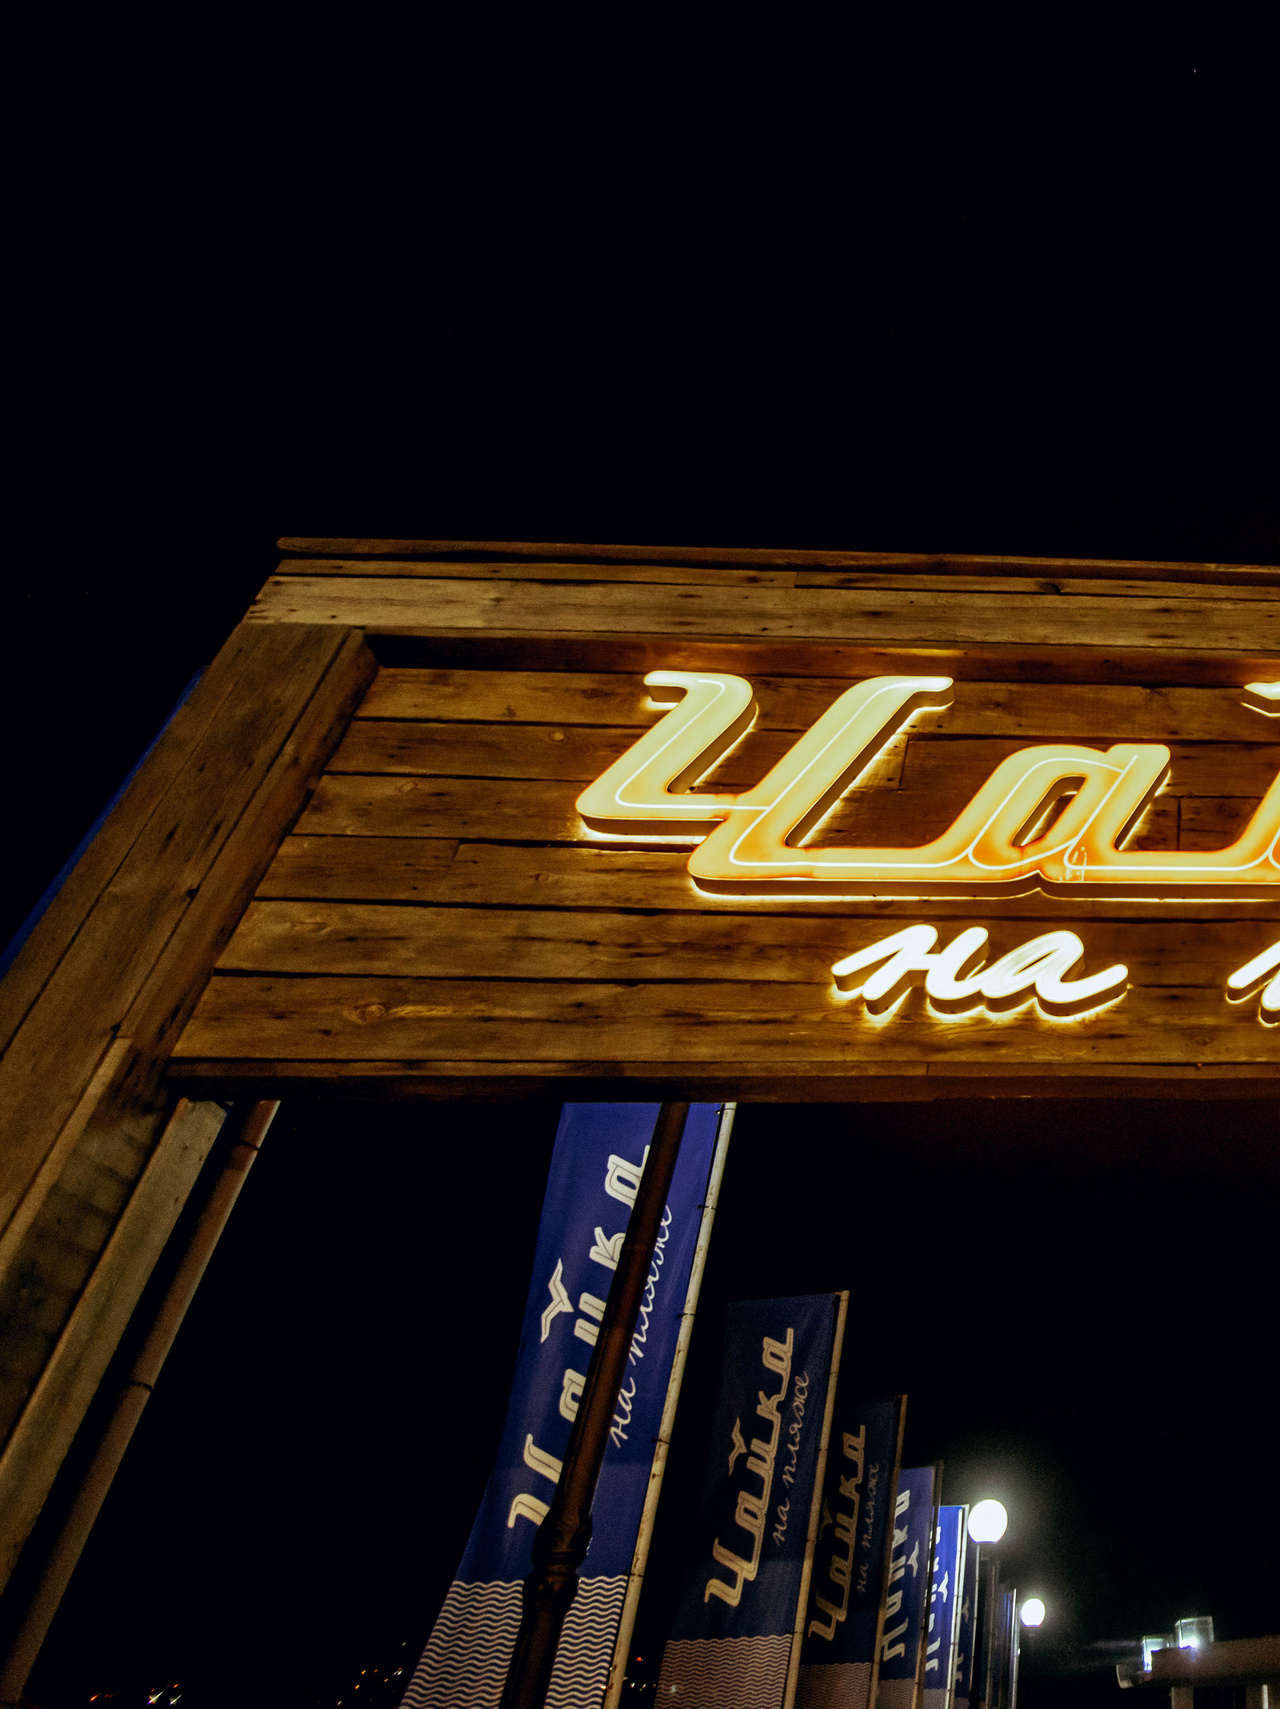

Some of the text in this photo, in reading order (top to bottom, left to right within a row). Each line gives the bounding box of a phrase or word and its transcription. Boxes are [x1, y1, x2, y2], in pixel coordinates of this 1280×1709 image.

[830, 923, 1130, 1016] на
[704, 1327, 795, 1608] Чайка
[771, 1370, 810, 1549] на пляже
[808, 1424, 866, 1642] Чайка
